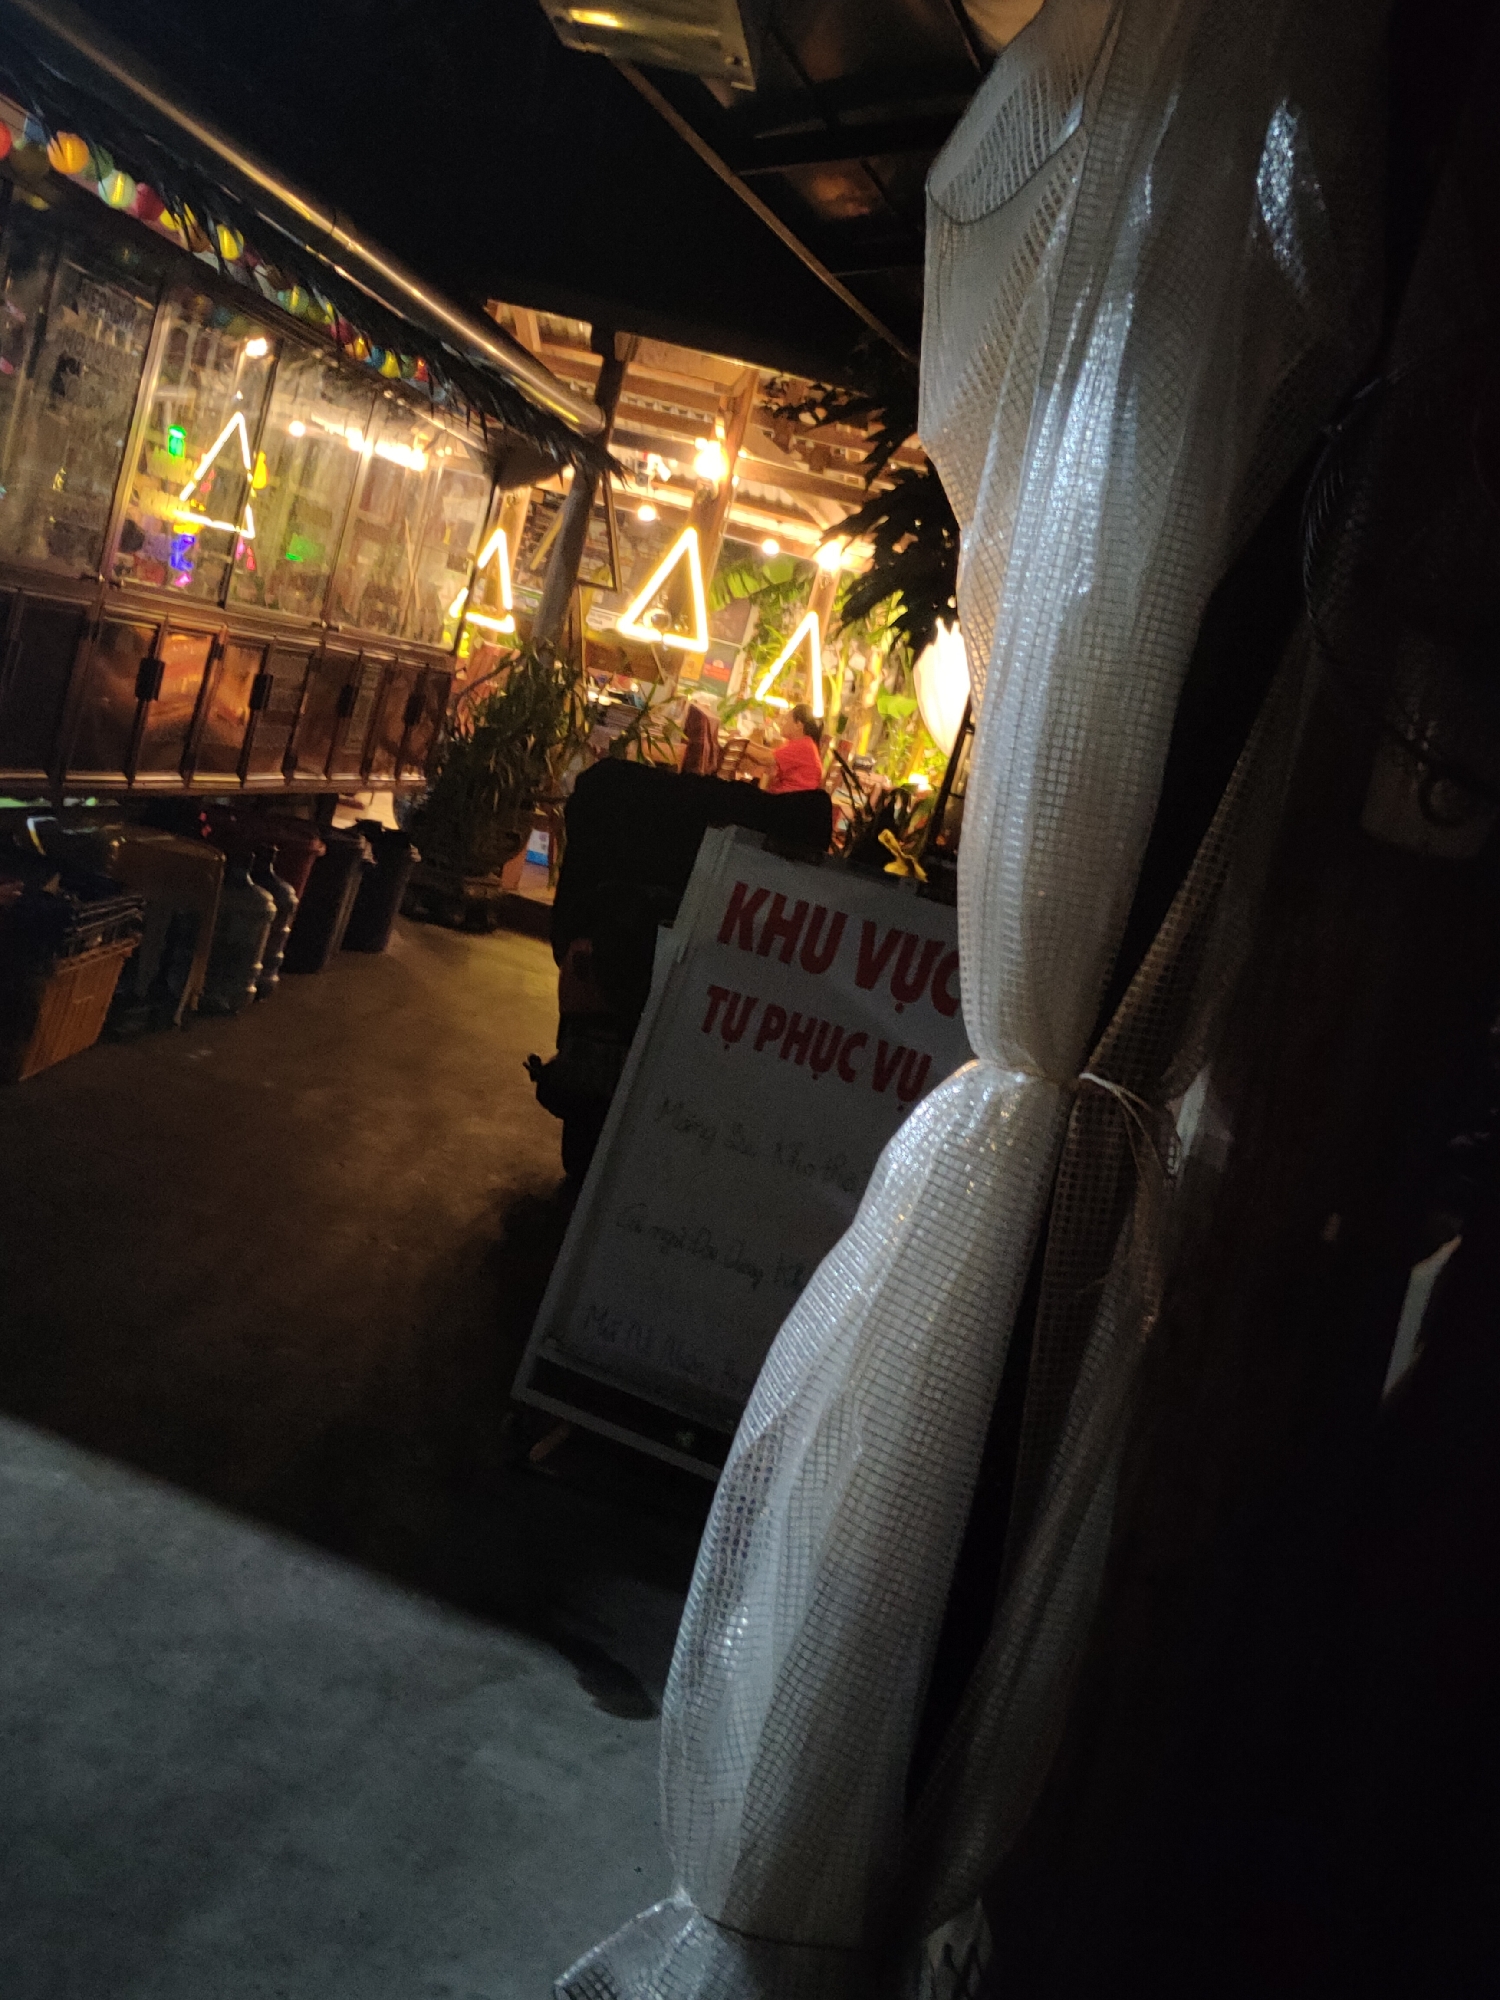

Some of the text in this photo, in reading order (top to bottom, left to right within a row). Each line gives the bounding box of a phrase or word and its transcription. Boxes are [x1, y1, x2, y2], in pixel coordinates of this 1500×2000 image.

[716, 880, 849, 975] KHU
[753, 1002, 869, 1084] PHỤC
[871, 1039, 933, 1113] VỤ
